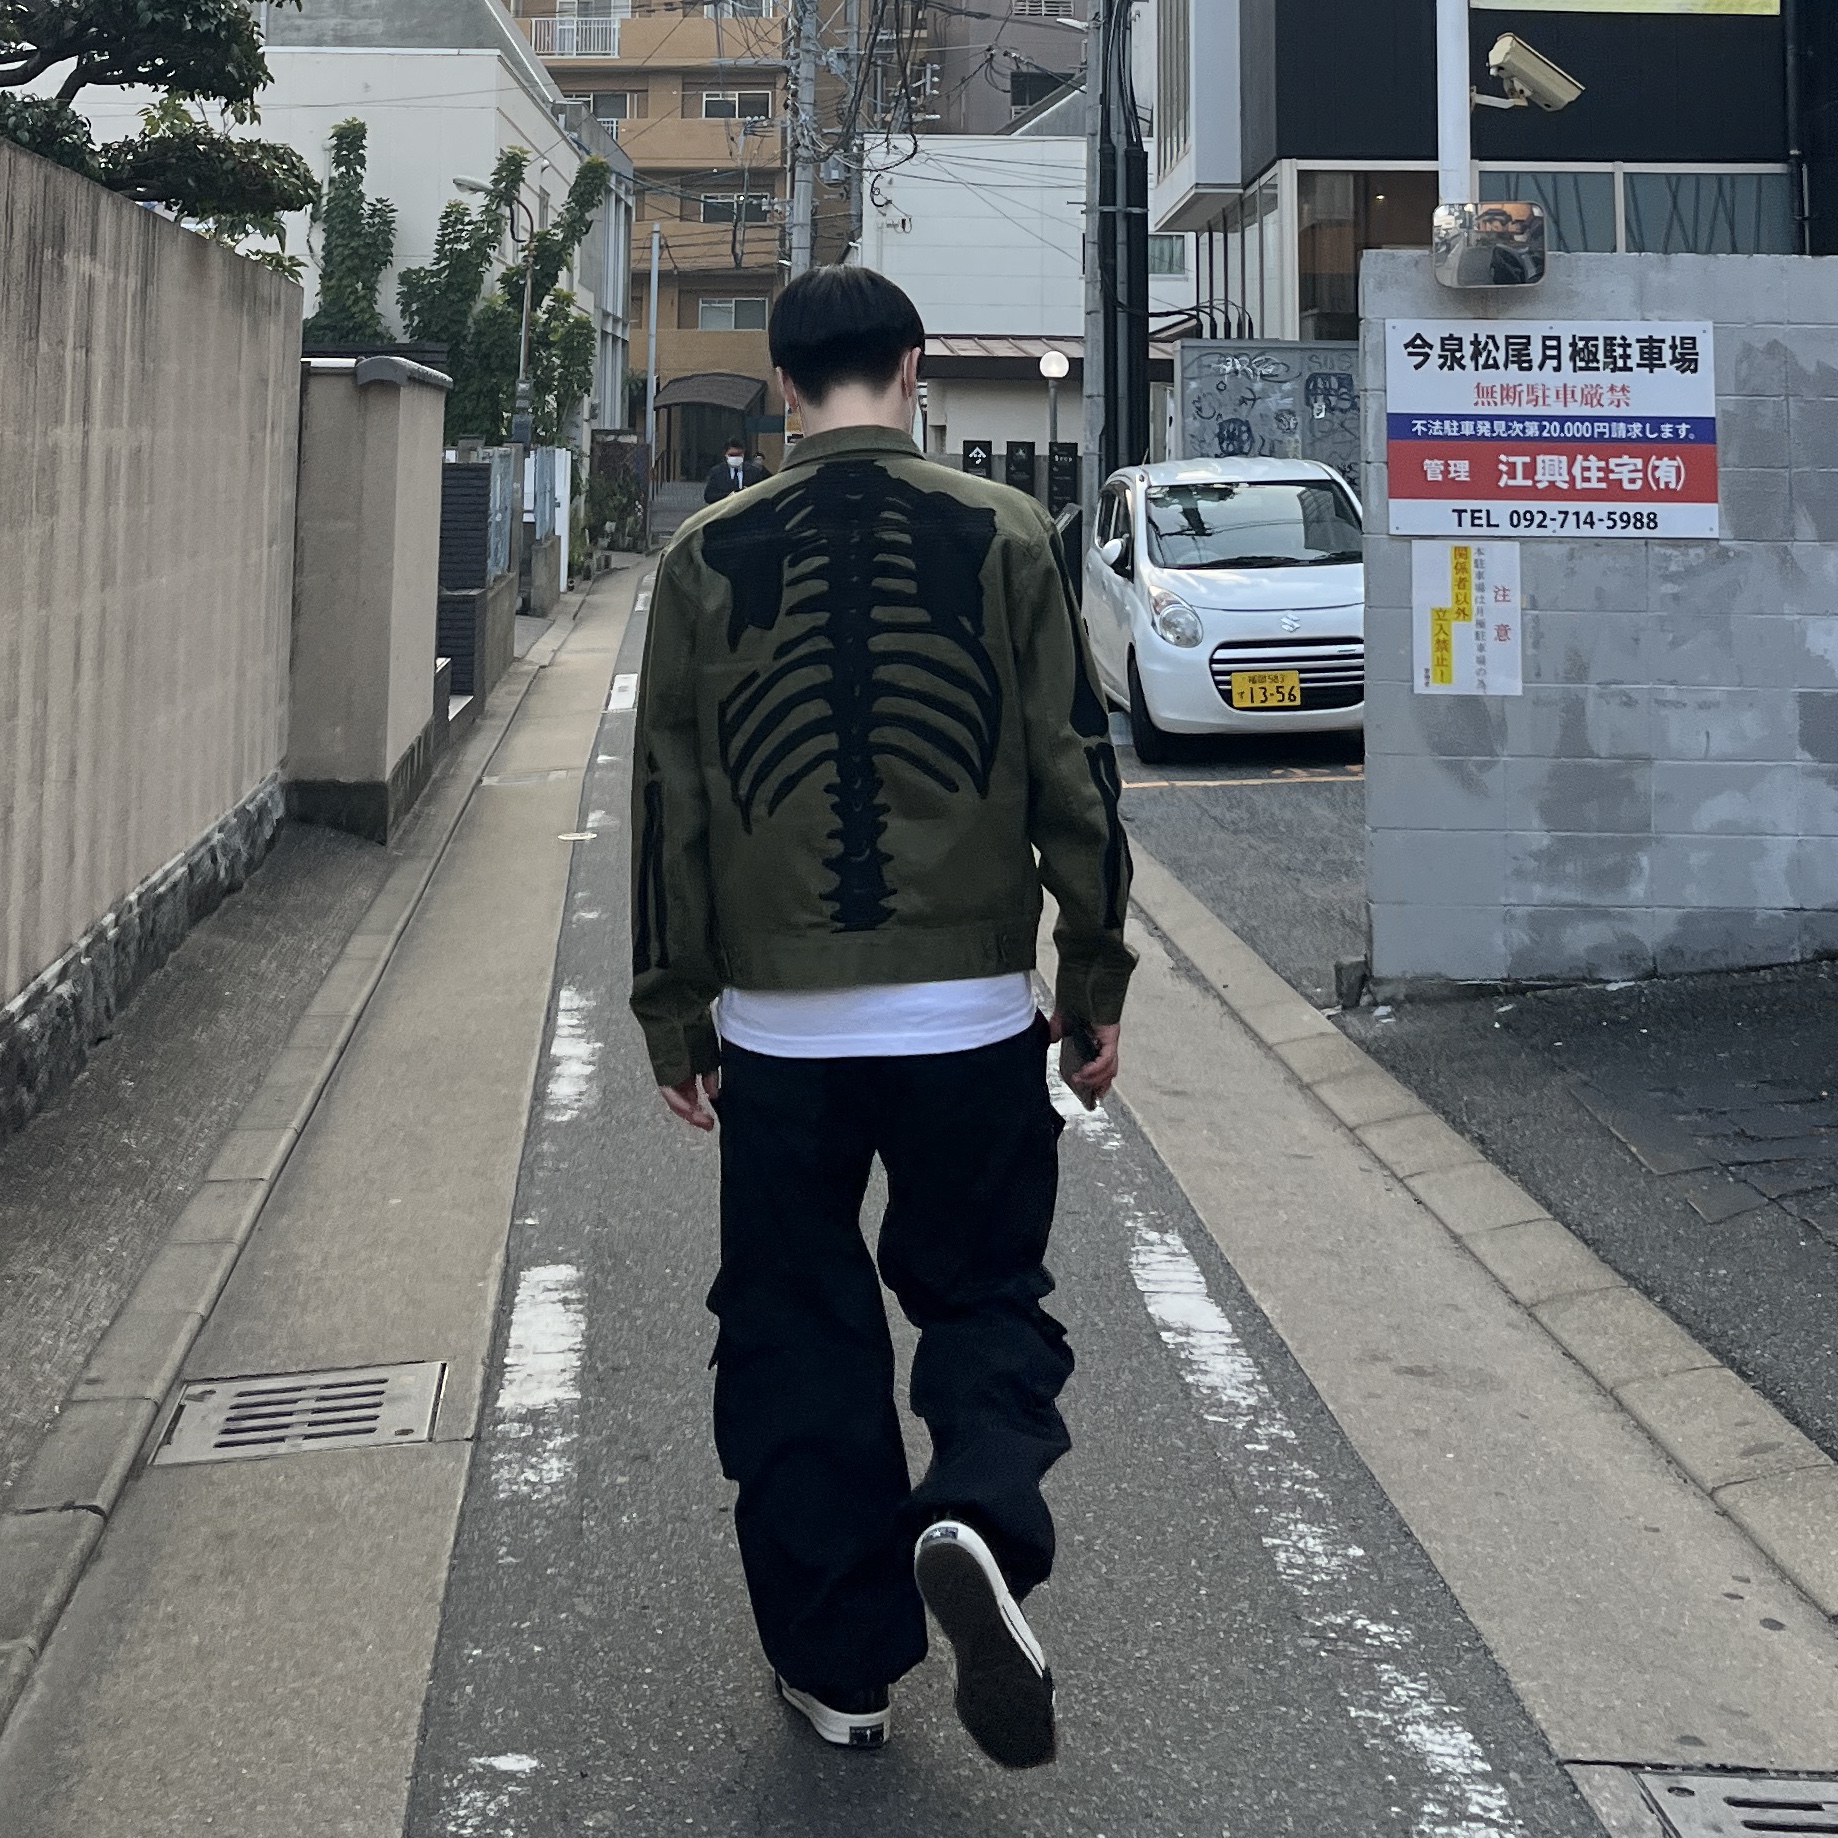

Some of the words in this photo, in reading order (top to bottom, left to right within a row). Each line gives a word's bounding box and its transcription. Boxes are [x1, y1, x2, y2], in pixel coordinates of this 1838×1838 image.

[1403, 332, 1700, 374] 今泉松尾月極駐車場
[1473, 382, 1632, 409] 無断駐車厳禁
[1423, 458, 1471, 482] 管理
[1452, 508, 1500, 528] TEL
[1509, 509, 1659, 530] 092-714-5988
[1453, 545, 1470, 621] 関係者以外
[1249, 685, 1297, 704] 13-56
